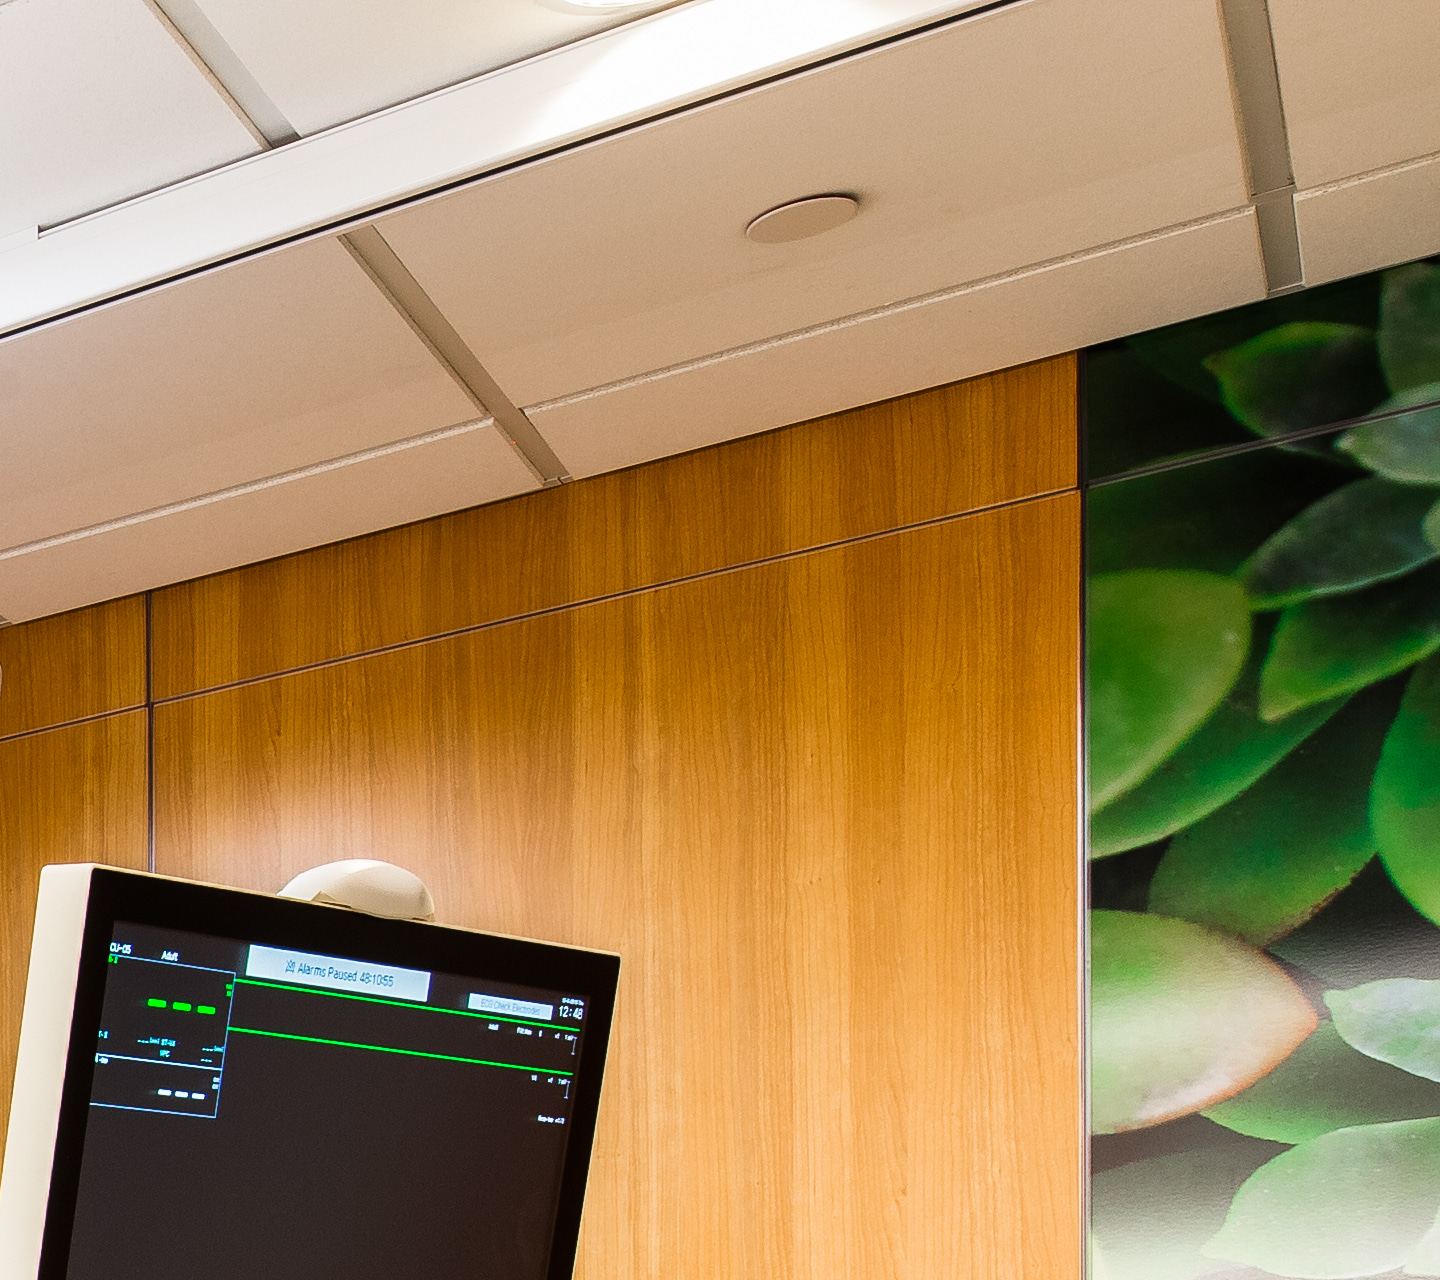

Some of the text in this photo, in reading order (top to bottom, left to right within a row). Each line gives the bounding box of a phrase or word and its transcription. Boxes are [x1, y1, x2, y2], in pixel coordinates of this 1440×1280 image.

[298, 963, 326, 978] Alarms
[328, 967, 358, 982] Paused
[559, 1006, 584, 1020] 12:48
